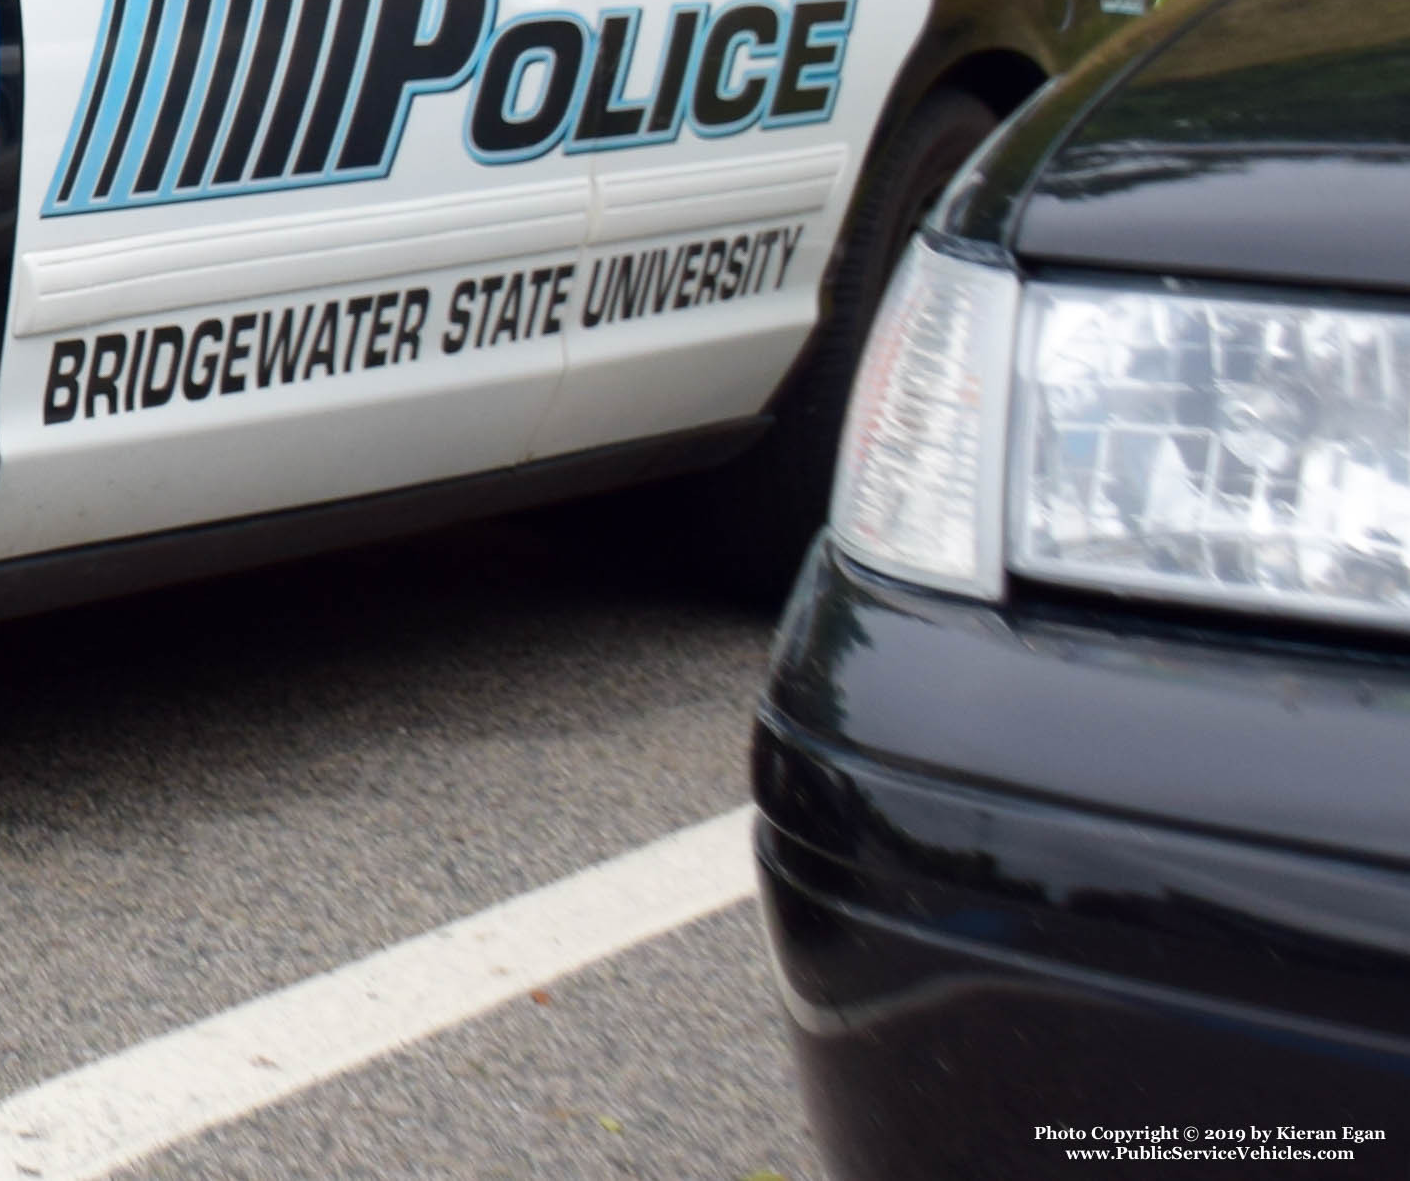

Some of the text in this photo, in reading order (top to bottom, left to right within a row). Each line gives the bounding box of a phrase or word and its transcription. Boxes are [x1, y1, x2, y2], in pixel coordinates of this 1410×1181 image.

[44, 226, 805, 424] BRIDGEWATER STATE UNIVERSITY
